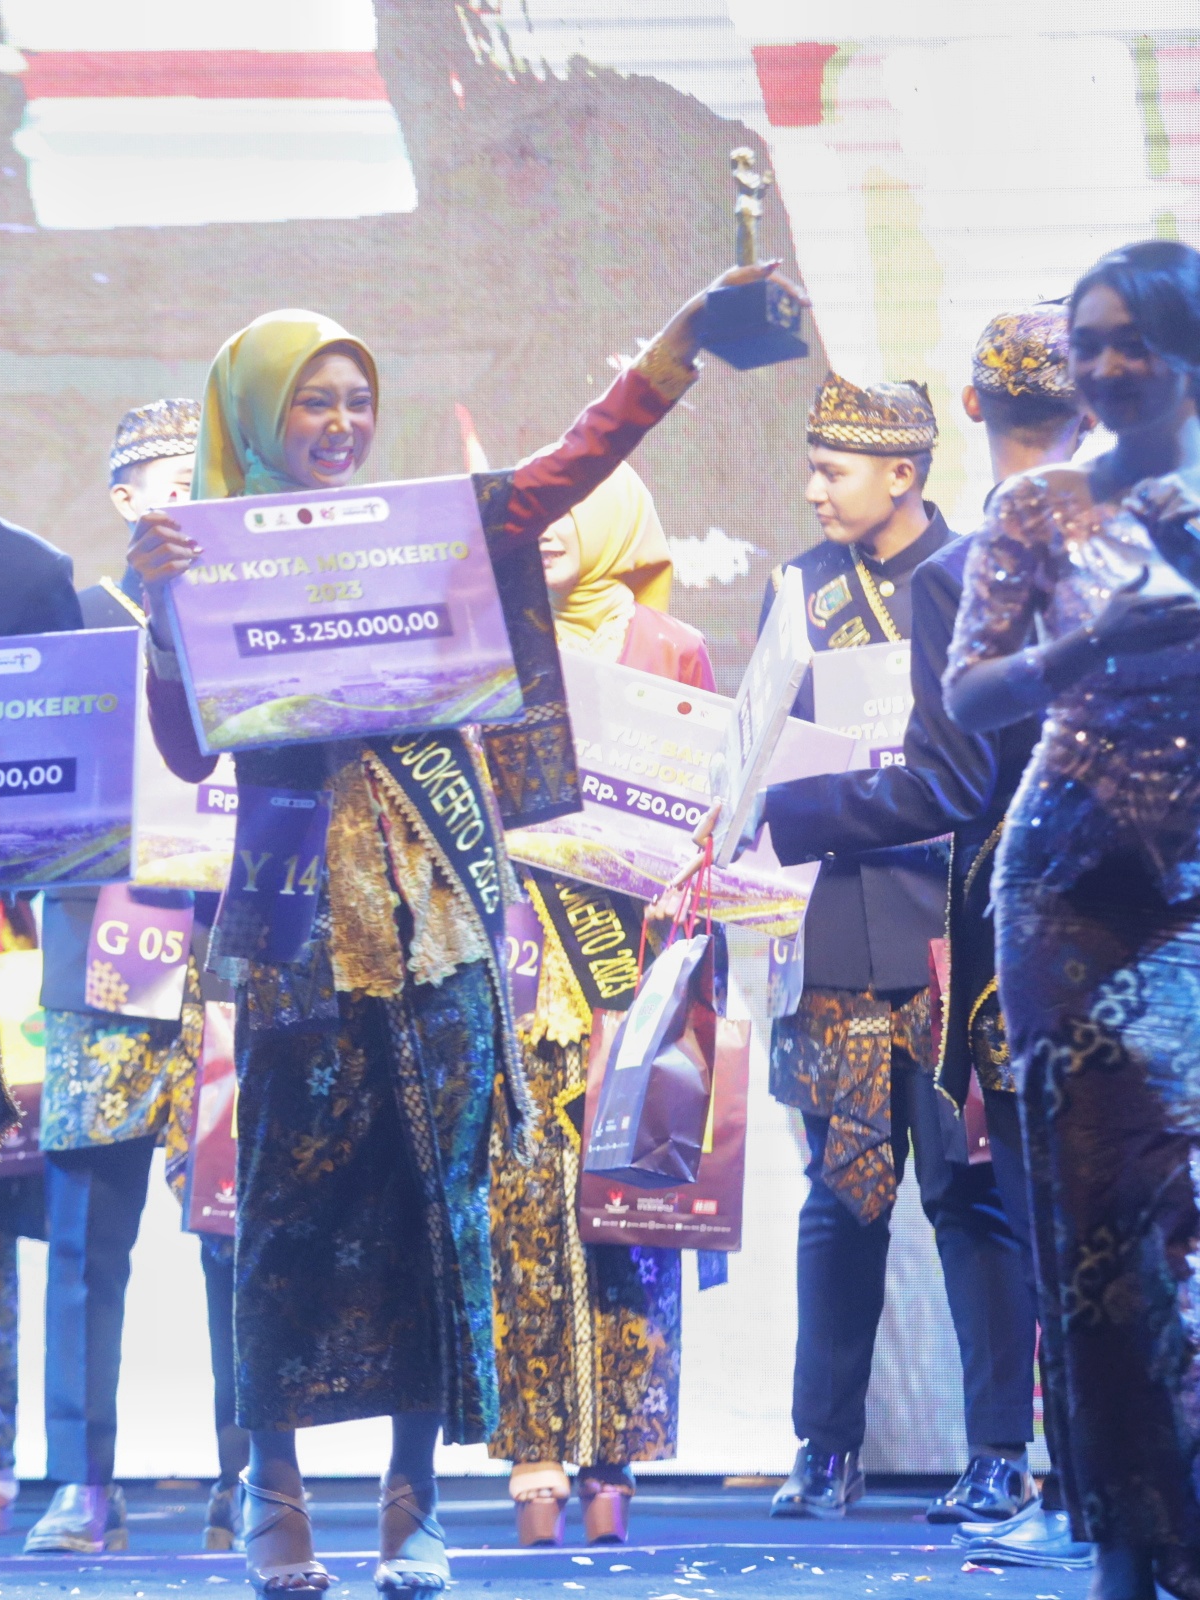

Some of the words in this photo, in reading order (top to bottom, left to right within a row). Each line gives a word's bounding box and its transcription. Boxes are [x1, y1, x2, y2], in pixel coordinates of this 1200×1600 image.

[186, 564, 237, 586] YUK
[242, 556, 311, 581] KOTA
[316, 541, 470, 573] MOJOKERTO
[306, 579, 363, 603] 2023
[247, 627, 286, 651] Rp.
[291, 610, 439, 645] 3.250.000,00
[839, 721, 888, 740] OTA
[582, 774, 618, 802] Rp.
[608, 750, 710, 794] MOJOKE
[240, 850, 273, 892] Y
[280, 854, 319, 896] 14
[97, 920, 130, 955] G
[138, 926, 184, 964] 05
